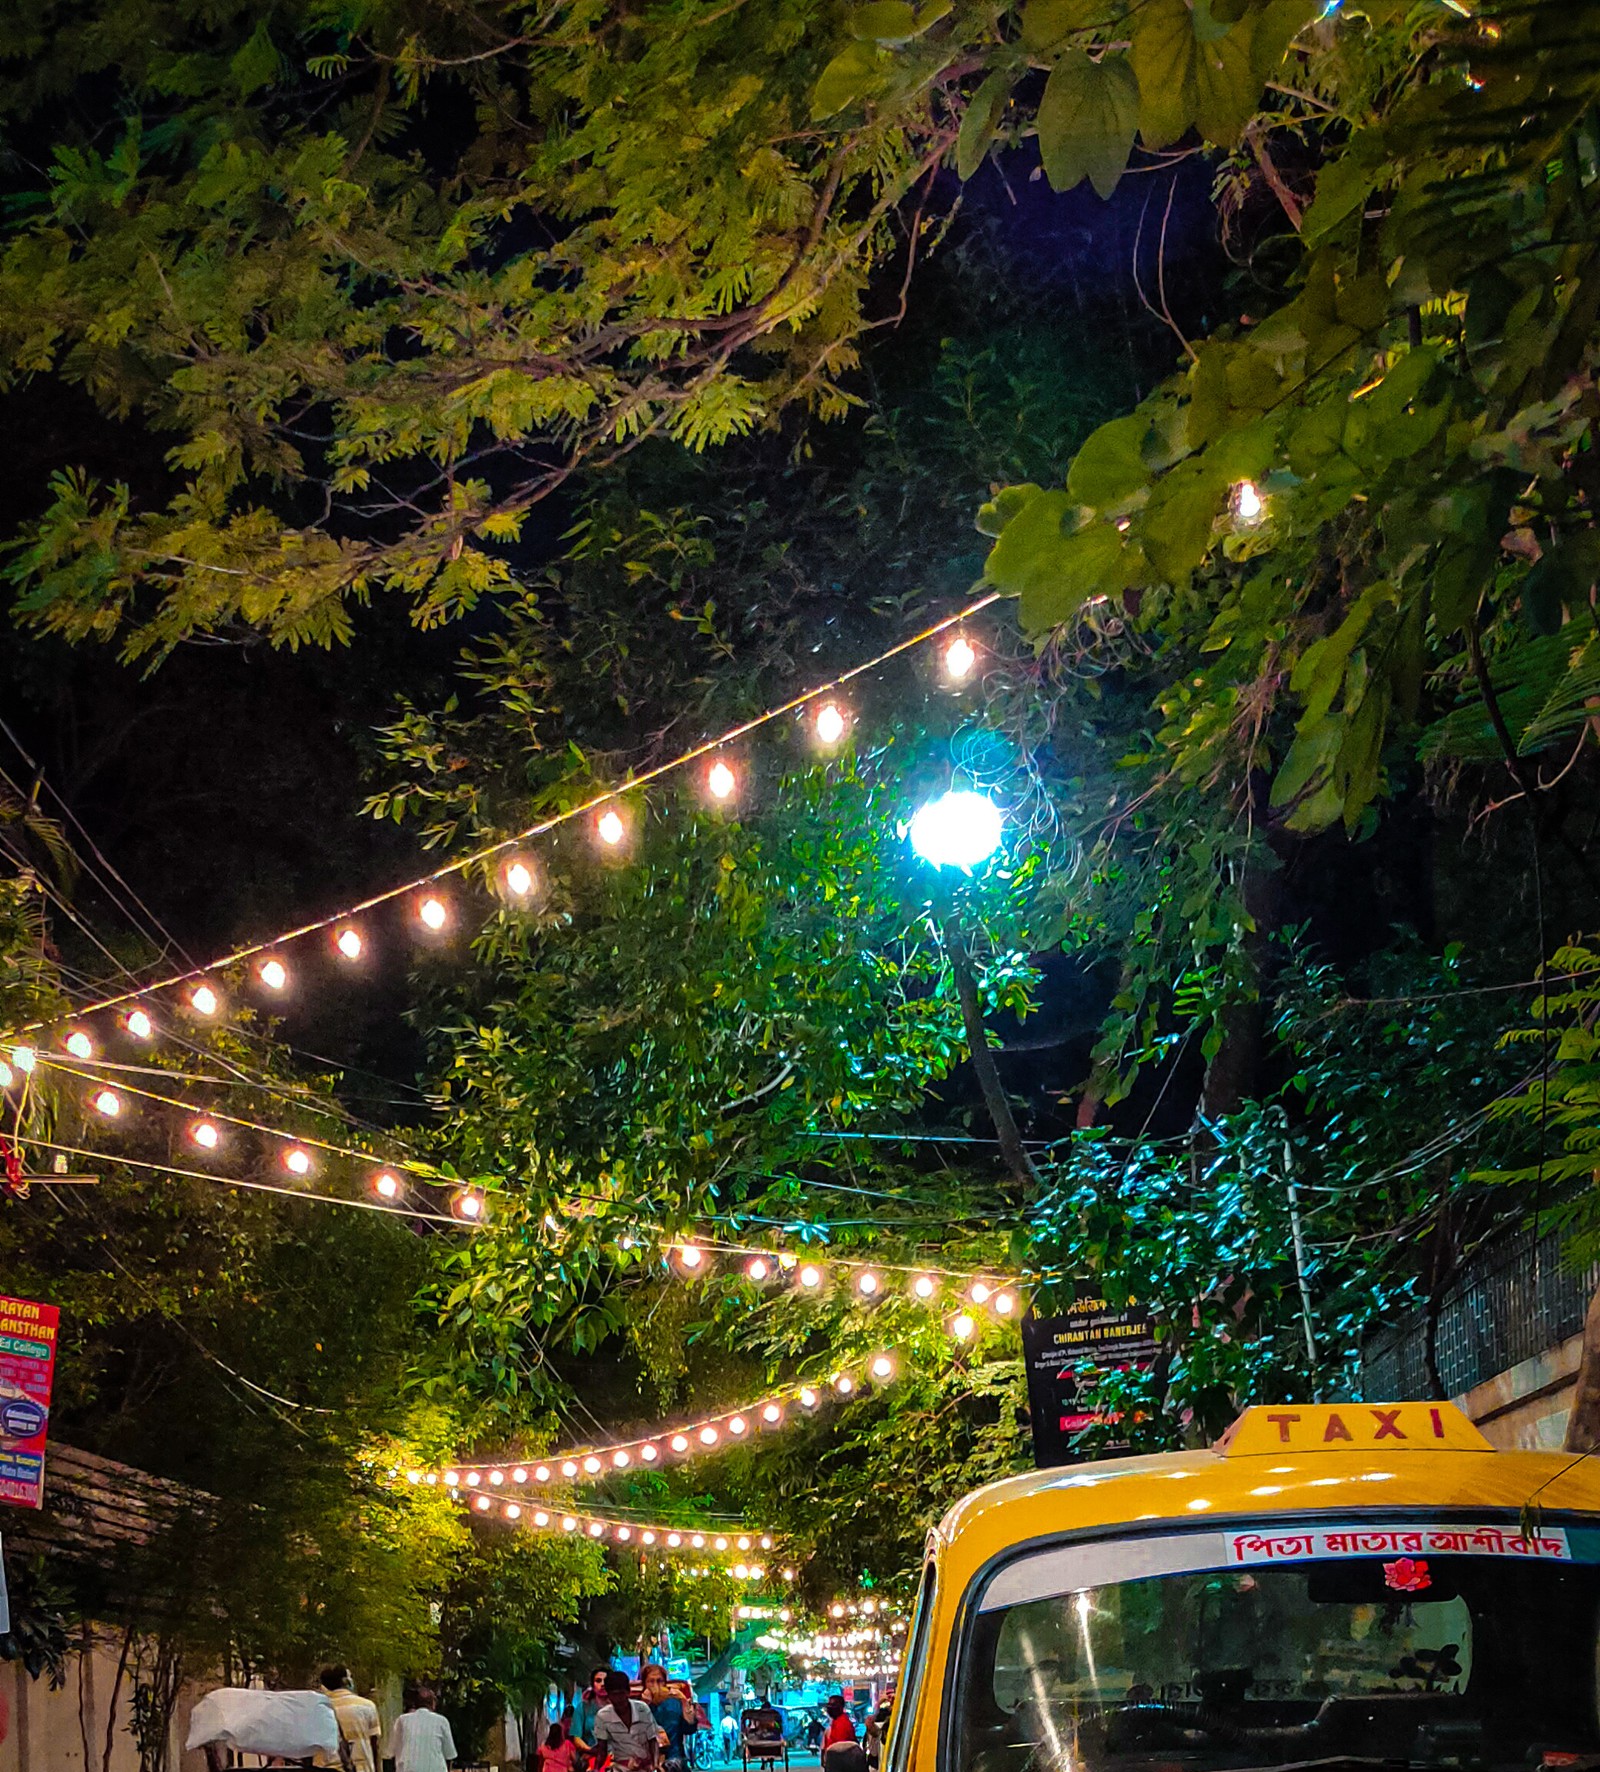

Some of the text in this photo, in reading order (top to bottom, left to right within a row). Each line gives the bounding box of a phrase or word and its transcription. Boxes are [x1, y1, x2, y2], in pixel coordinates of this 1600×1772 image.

[0, 1300, 39, 1319] RAYAN
[0, 1318, 55, 1340] ANSTHAN
[1053, 1328, 1101, 1344] CHIRANTAN
[13, 1340, 48, 1358] College
[1267, 1408, 1444, 1442] TAXI
[1233, 1534, 1316, 1561] পিতা
[1323, 1531, 1424, 1554] মাতার
